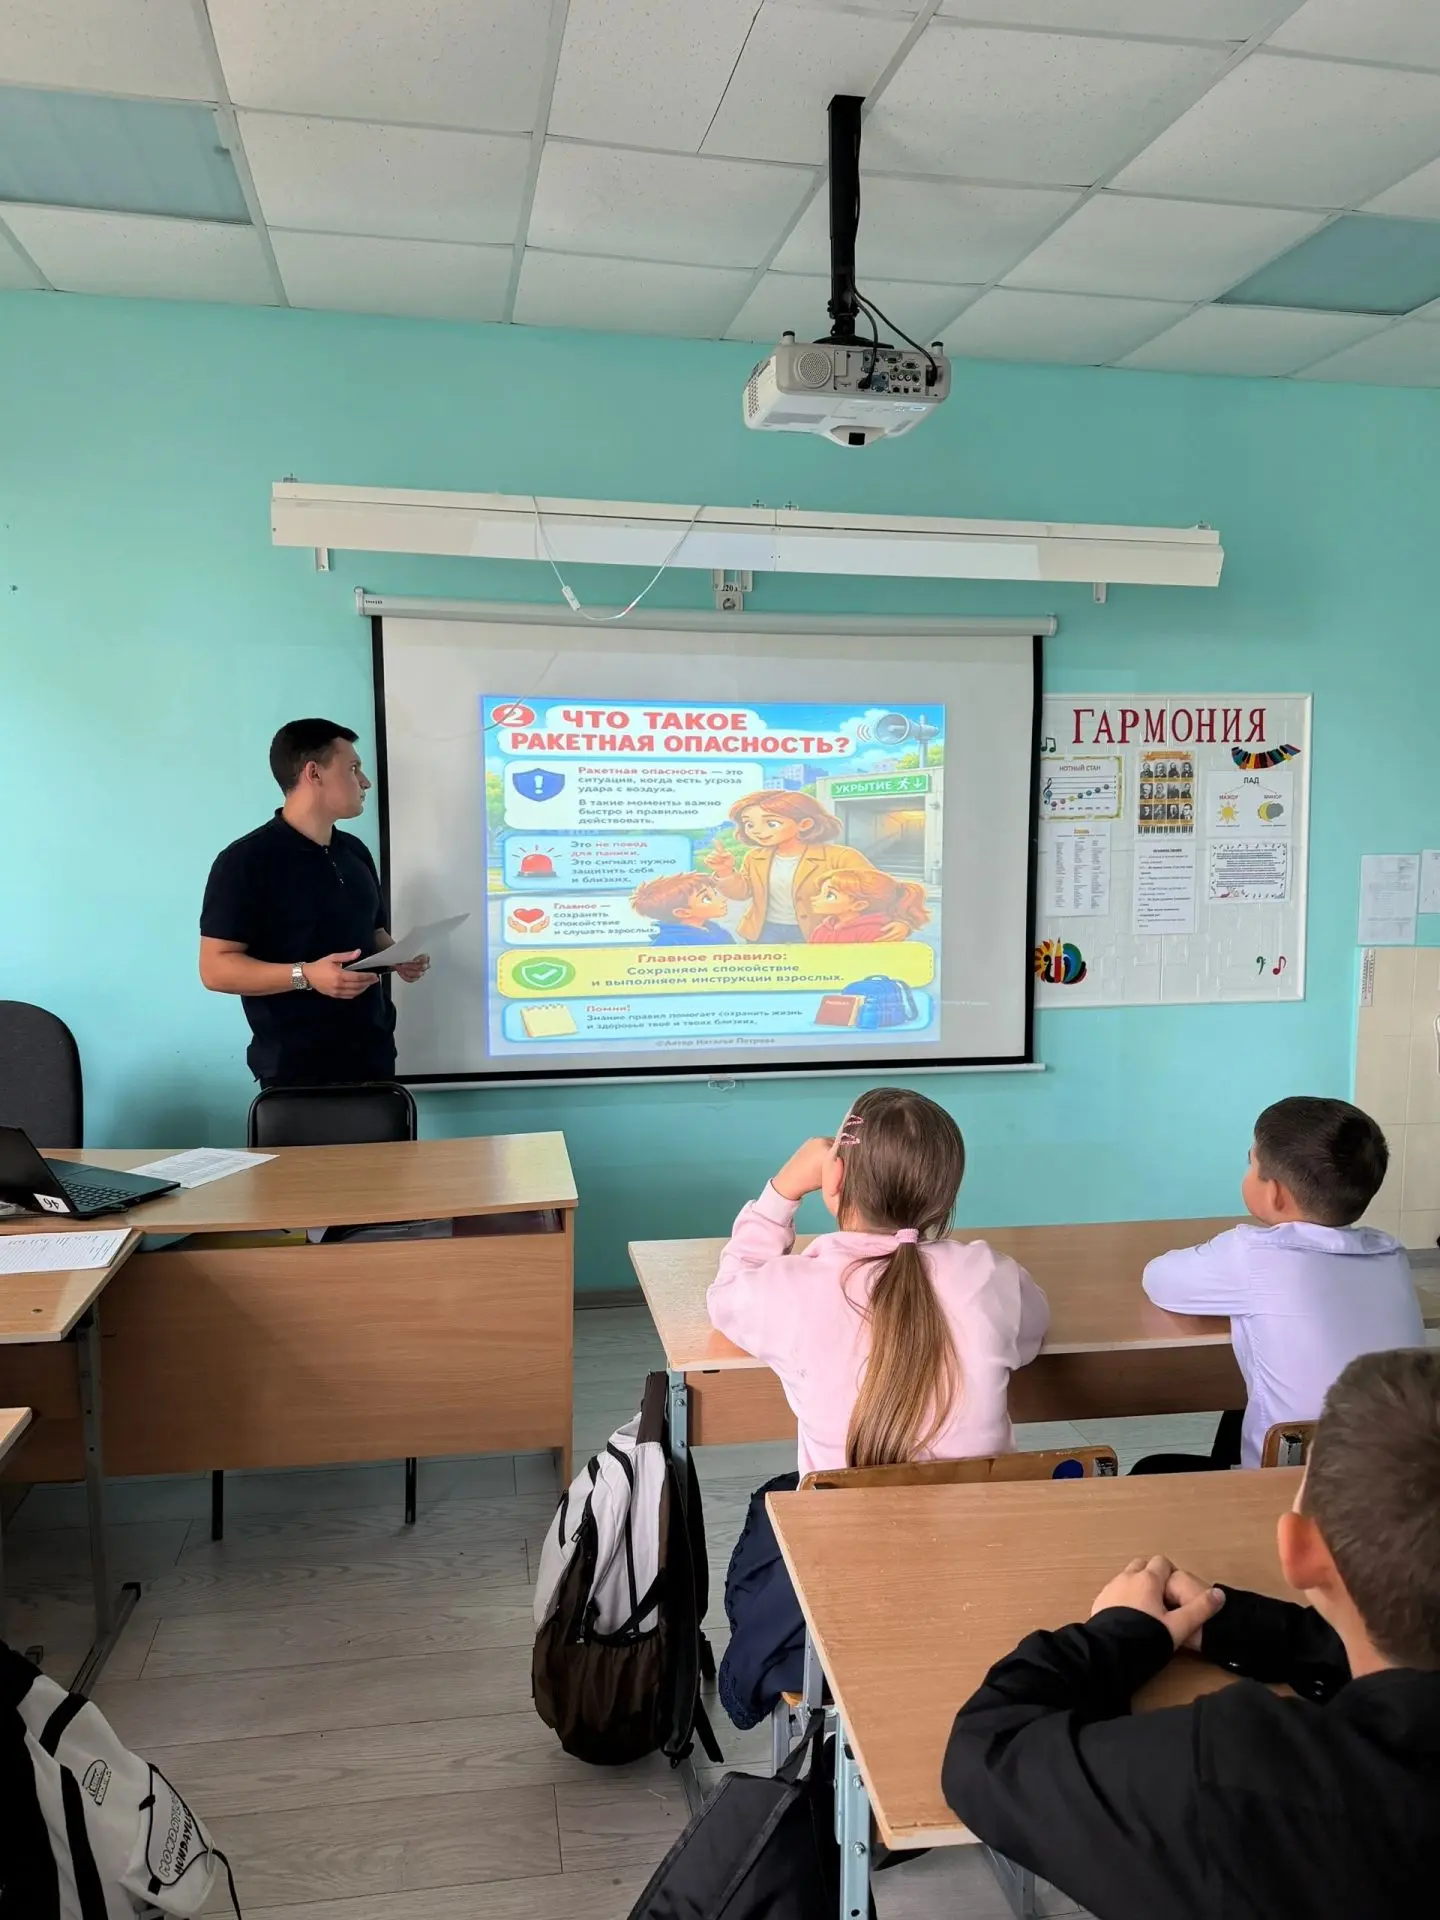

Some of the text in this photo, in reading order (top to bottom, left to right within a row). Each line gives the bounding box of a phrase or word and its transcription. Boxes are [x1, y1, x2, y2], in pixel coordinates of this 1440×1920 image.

[502, 707, 524, 725] 2
[562, 709, 748, 731] ЧТО ТАКОЕ
[1072, 708, 1267, 744] ГАРМОНИЯ
[511, 732, 850, 754] РАКЕТНАЯ ОПАСНОСТЬ?
[578, 766, 638, 775] Ракетная
[641, 768, 707, 776] опасность
[1059, 764, 1101, 772] НОТНЫЙ СТАН
[578, 777, 636, 785] ситуация,
[639, 777, 673, 785] когда
[705, 777, 742, 786] угроза
[1243, 776, 1260, 785] ЛАД
[578, 785, 613, 794] удара
[625, 786, 676, 794] воздуха.
[835, 779, 893, 795] УКРЫТИЕ
[578, 808, 622, 816] быстро
[578, 817, 655, 825] действовать.
[612, 841, 648, 849] повод
[637, 953, 788, 963] Главное правило:
[627, 964, 800, 976] Сохраняем спокойствие
[605, 977, 688, 987] выполняем
[692, 975, 772, 984] инструкции
[776, 974, 845, 983] взрослых.
[586, 1004, 631, 1012] Помни!
[628, 1013, 667, 1021] правил
[718, 1010, 770, 1018] сохранить
[43, 1198, 60, 1210] 46
